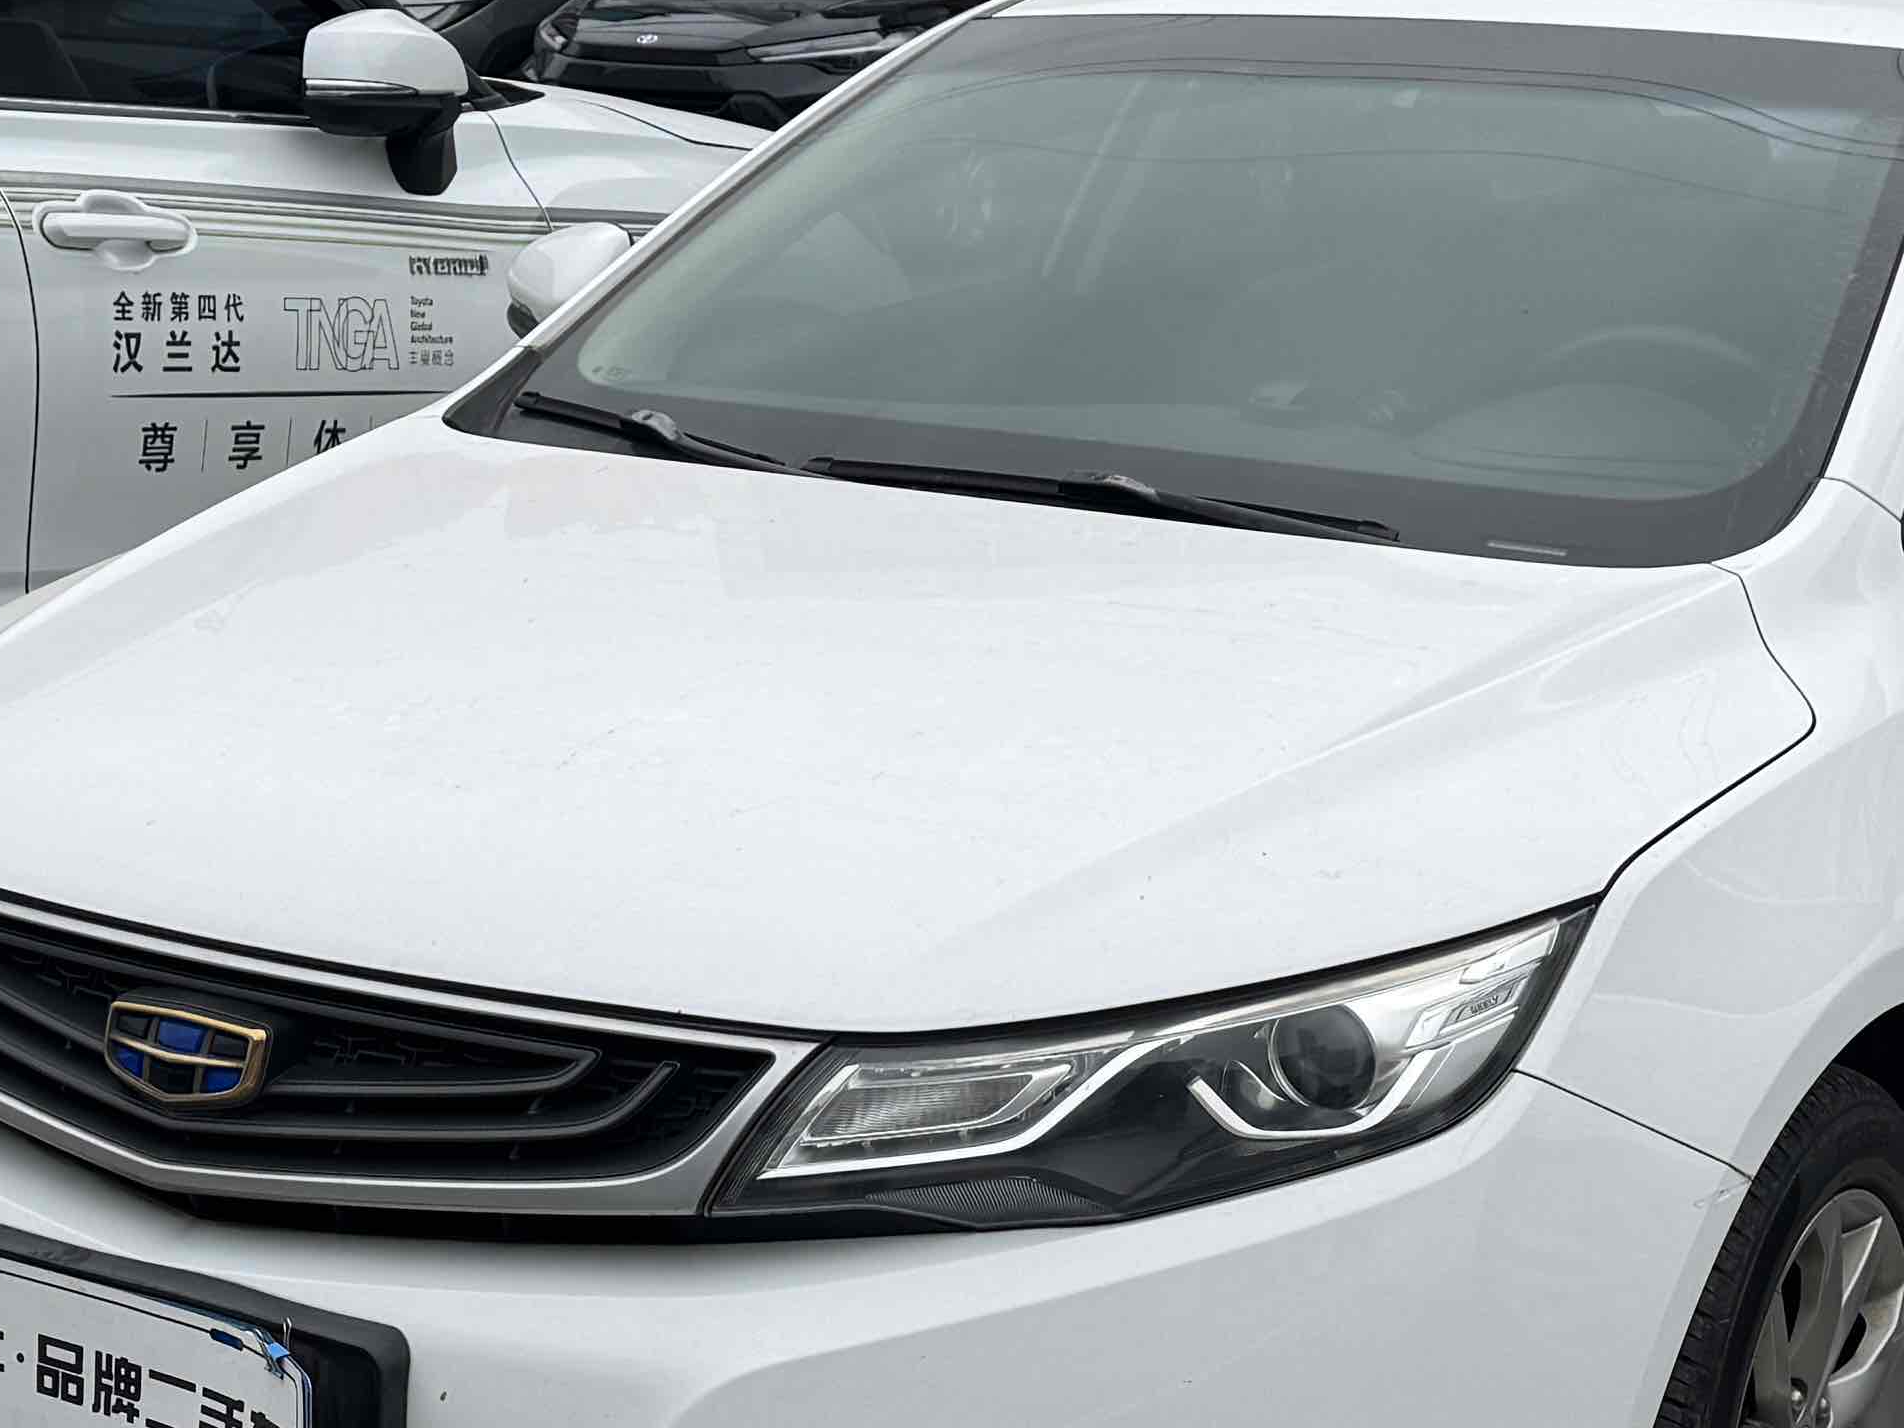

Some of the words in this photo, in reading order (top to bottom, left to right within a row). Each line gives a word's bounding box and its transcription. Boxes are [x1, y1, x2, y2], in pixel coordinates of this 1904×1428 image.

[112, 291, 245, 323] 全新第四代
[112, 330, 242, 374] 汉兰达
[283, 296, 399, 371] TNGA
